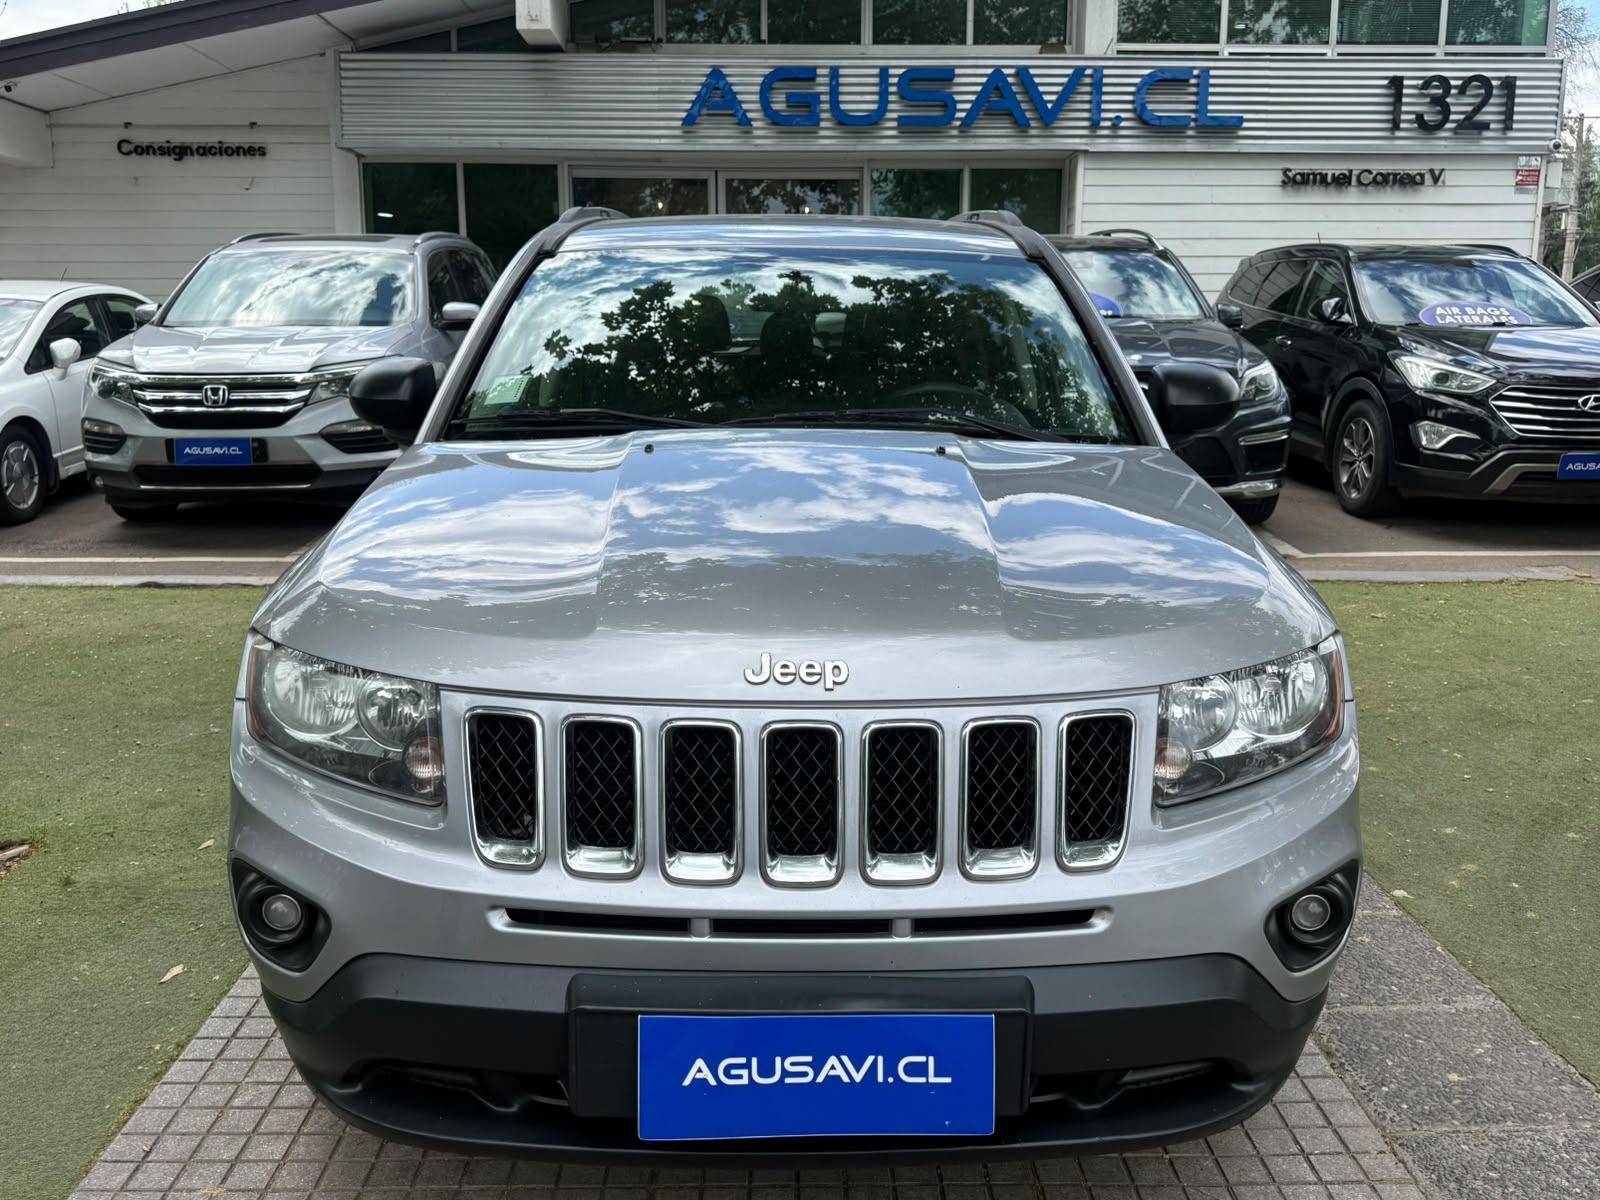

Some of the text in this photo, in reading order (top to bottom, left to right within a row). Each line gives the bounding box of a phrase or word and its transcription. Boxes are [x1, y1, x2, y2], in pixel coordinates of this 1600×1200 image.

[681, 66, 1245, 128] AGUSAVI.CL
[1386, 74, 1517, 132] 1321
[116, 138, 267, 161] Consignaciones
[1281, 168, 1353, 187] Samuel
[1356, 168, 1426, 187] Correa
[1435, 306, 1510, 316] AIR BAGS
[183, 446, 243, 455] AGUSAVI.CL
[743, 651, 850, 692] Jeep
[682, 1055, 952, 1086] AGUSAVI.CL
